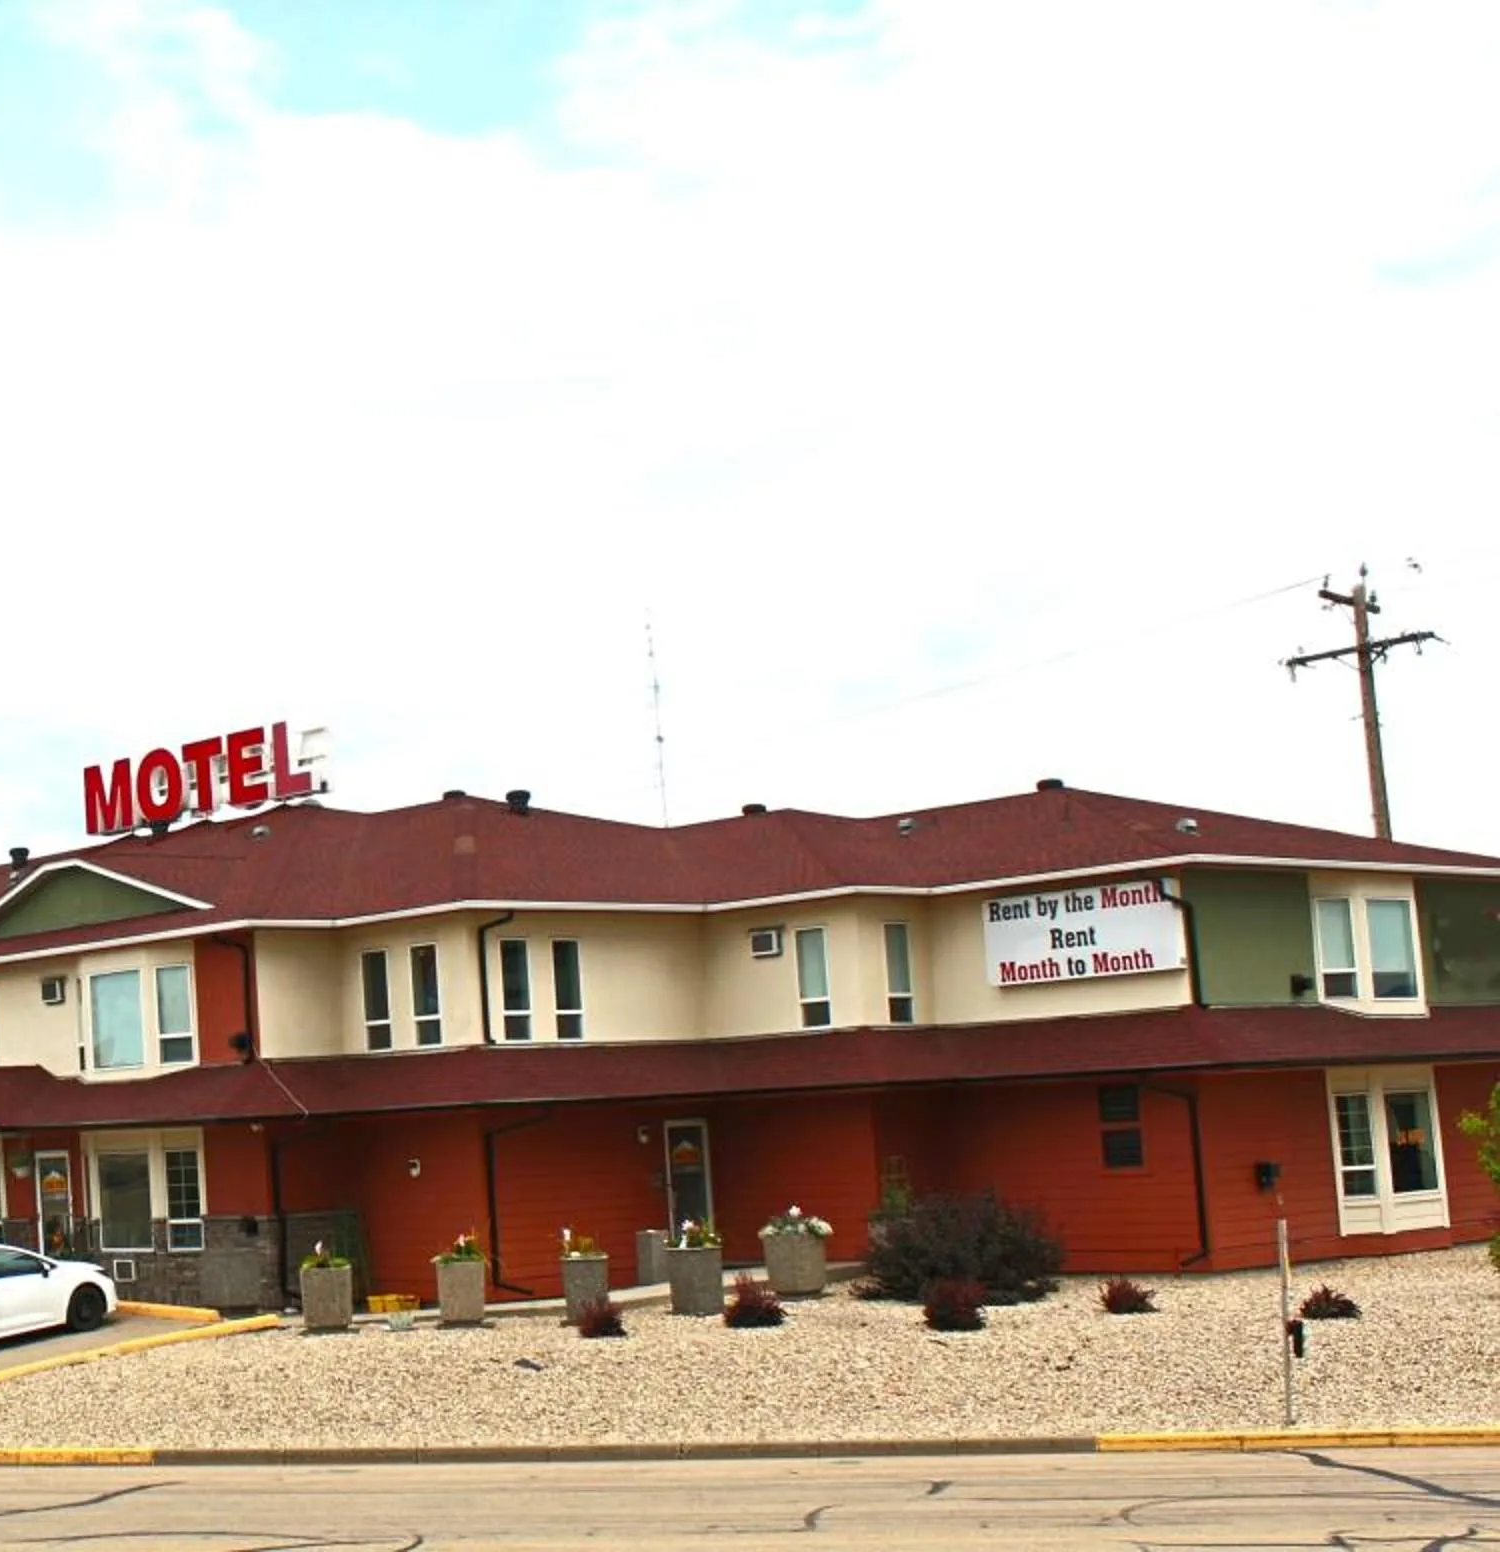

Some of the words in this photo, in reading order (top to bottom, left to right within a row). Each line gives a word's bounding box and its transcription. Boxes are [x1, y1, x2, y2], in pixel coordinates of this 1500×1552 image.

[83, 721, 312, 836] MOTEL
[989, 901, 1031, 922] Rent
[1037, 896, 1059, 920] by
[1065, 892, 1094, 913] the
[1050, 926, 1097, 949] Rent
[999, 958, 1061, 982] Month
[1067, 957, 1086, 976] to
[1092, 948, 1155, 974] Month
